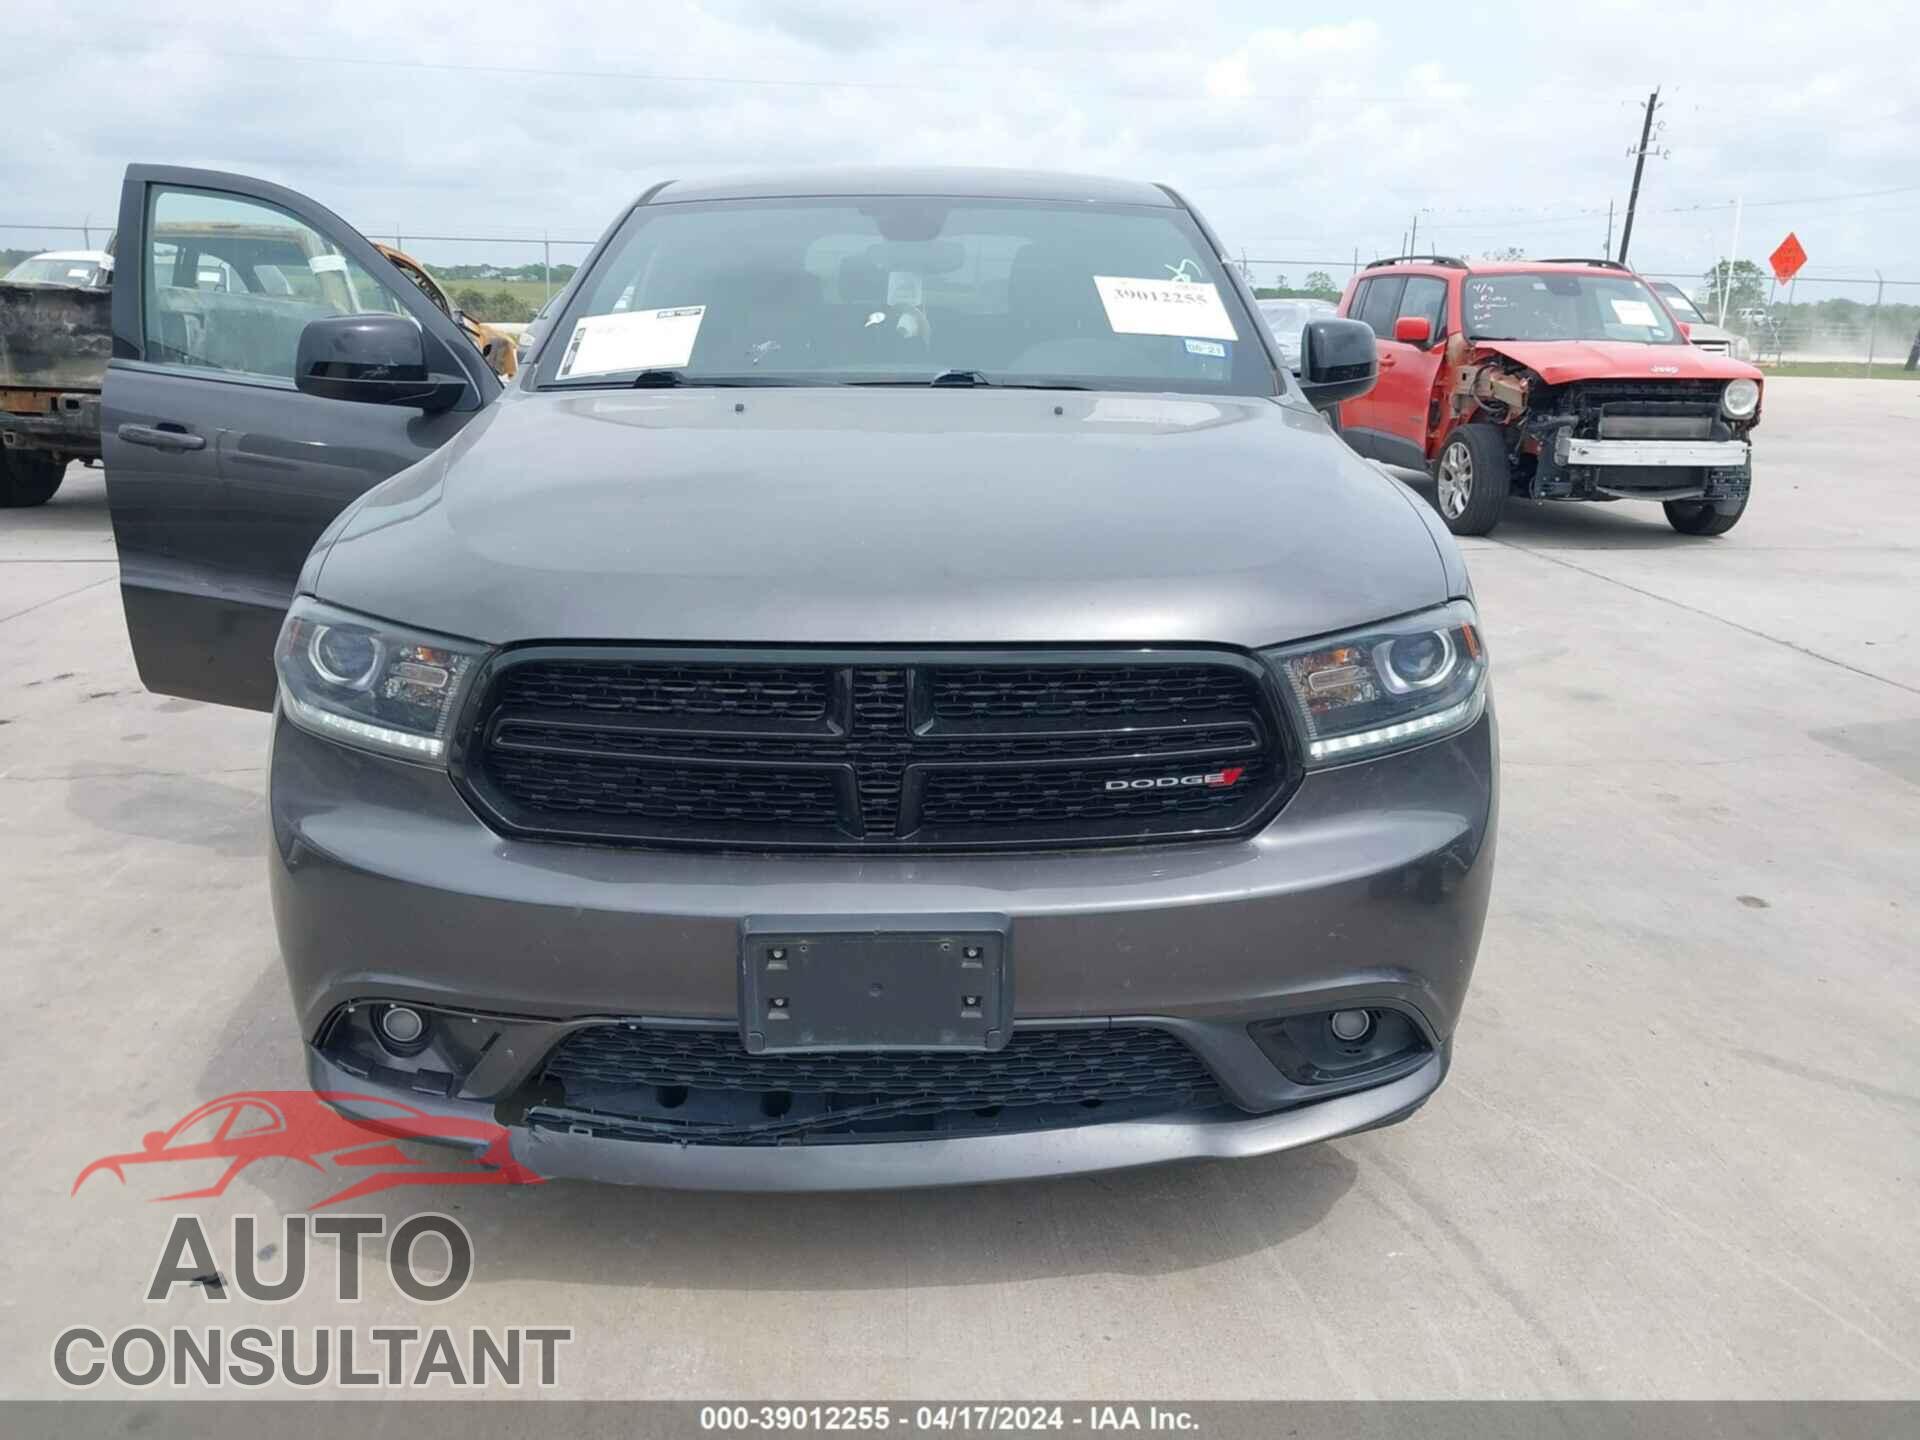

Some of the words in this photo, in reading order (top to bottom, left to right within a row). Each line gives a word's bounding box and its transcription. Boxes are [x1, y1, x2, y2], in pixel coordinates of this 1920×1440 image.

[1112, 287, 1208, 305] 39012255
[1650, 364, 1680, 375] Jeep
[1105, 772, 1225, 790] DODGE
